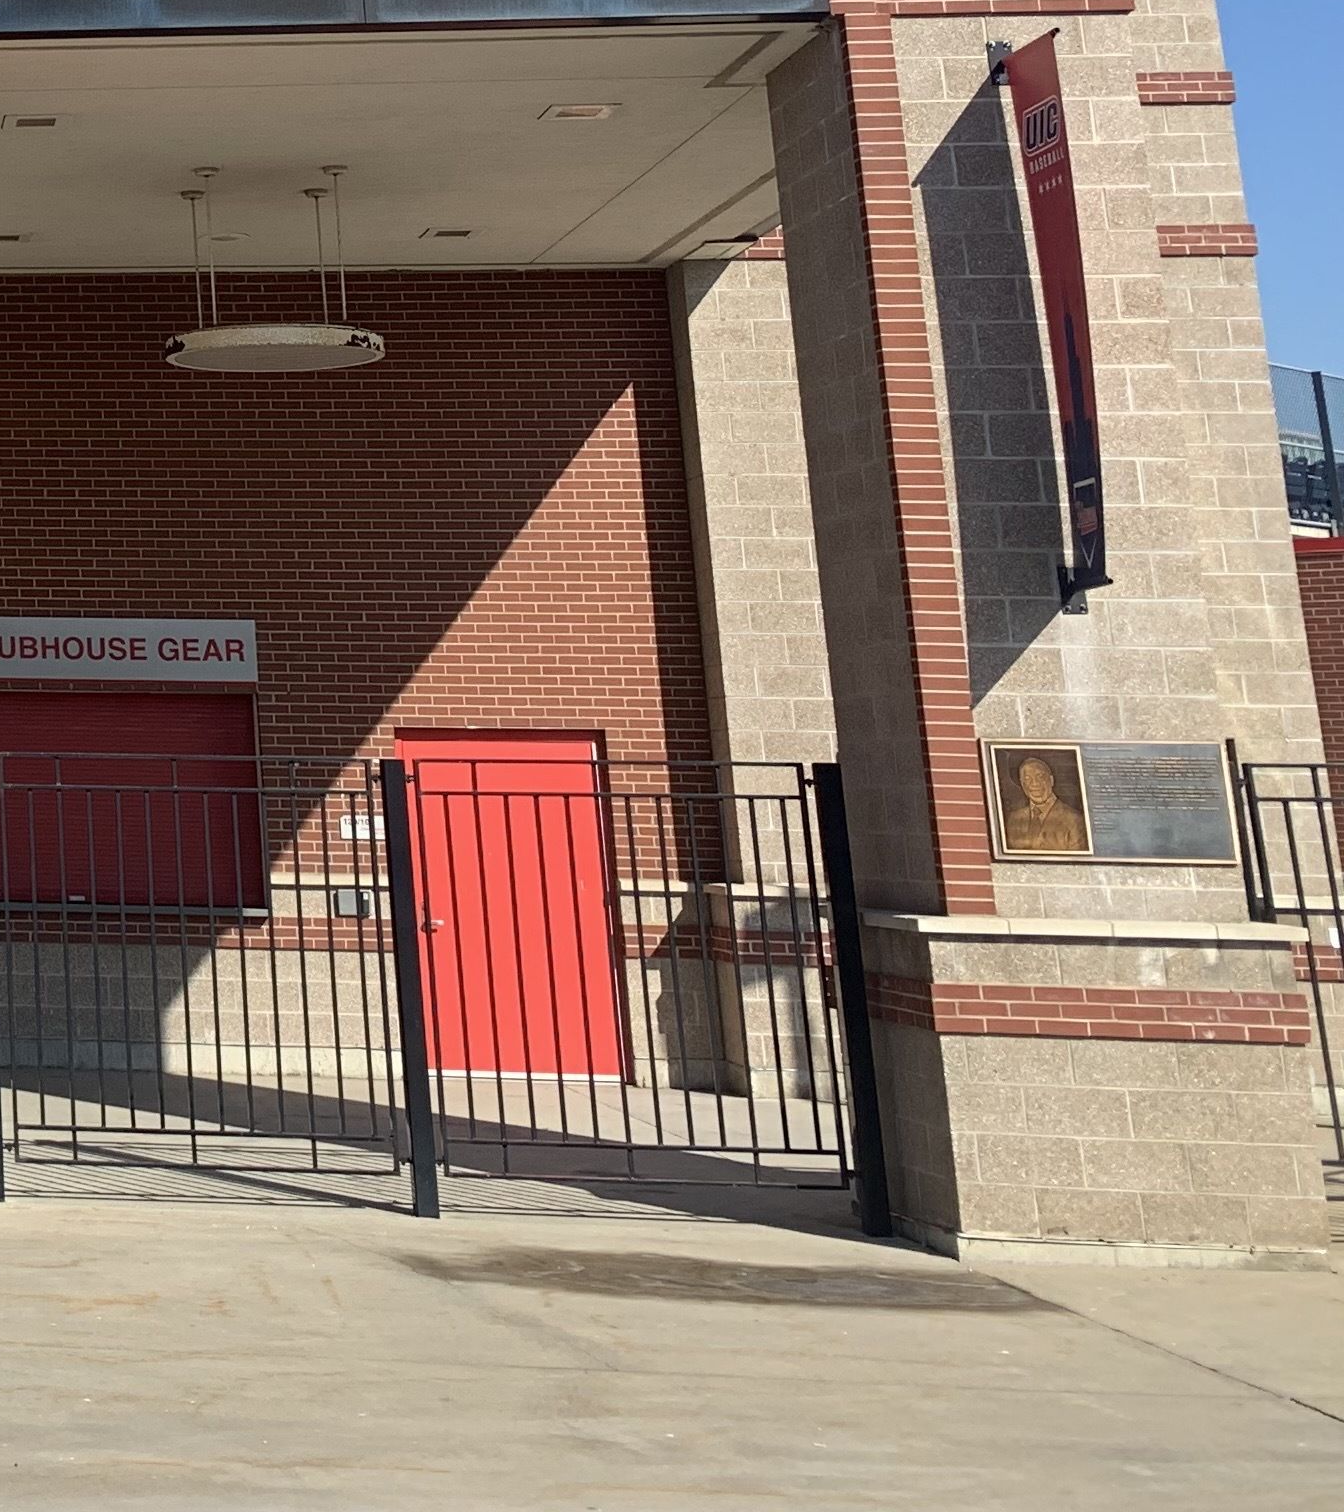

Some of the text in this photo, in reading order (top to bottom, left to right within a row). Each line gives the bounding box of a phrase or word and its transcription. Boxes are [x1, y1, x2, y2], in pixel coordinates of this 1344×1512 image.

[1024, 99, 1060, 153] UIC
[1029, 146, 1065, 175] BASEBALL
[157, 637, 246, 663] GEAR
